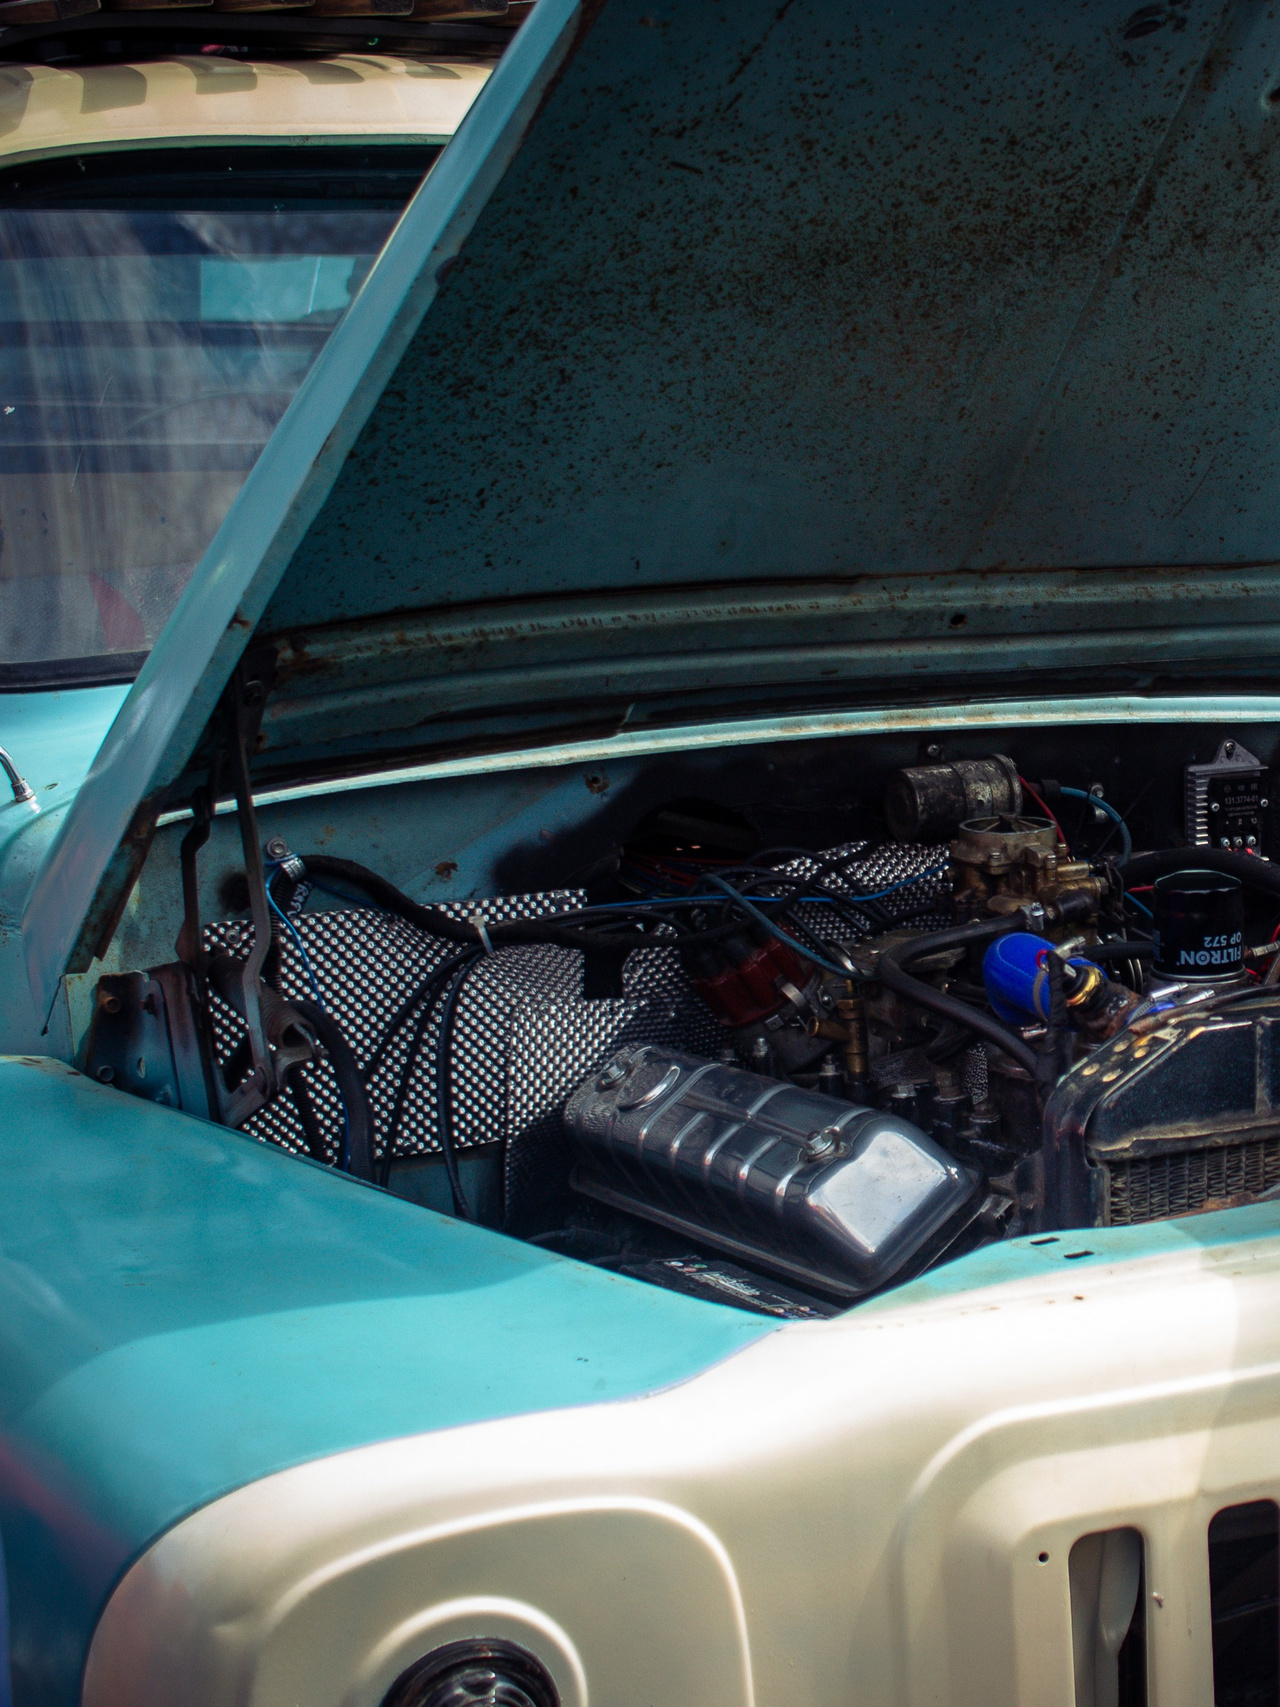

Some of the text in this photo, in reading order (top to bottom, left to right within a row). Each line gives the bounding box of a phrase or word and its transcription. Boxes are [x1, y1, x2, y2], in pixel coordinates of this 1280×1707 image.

[1204, 932, 1242, 948] OP 572
[1180, 946, 1242, 966] FILTRON
